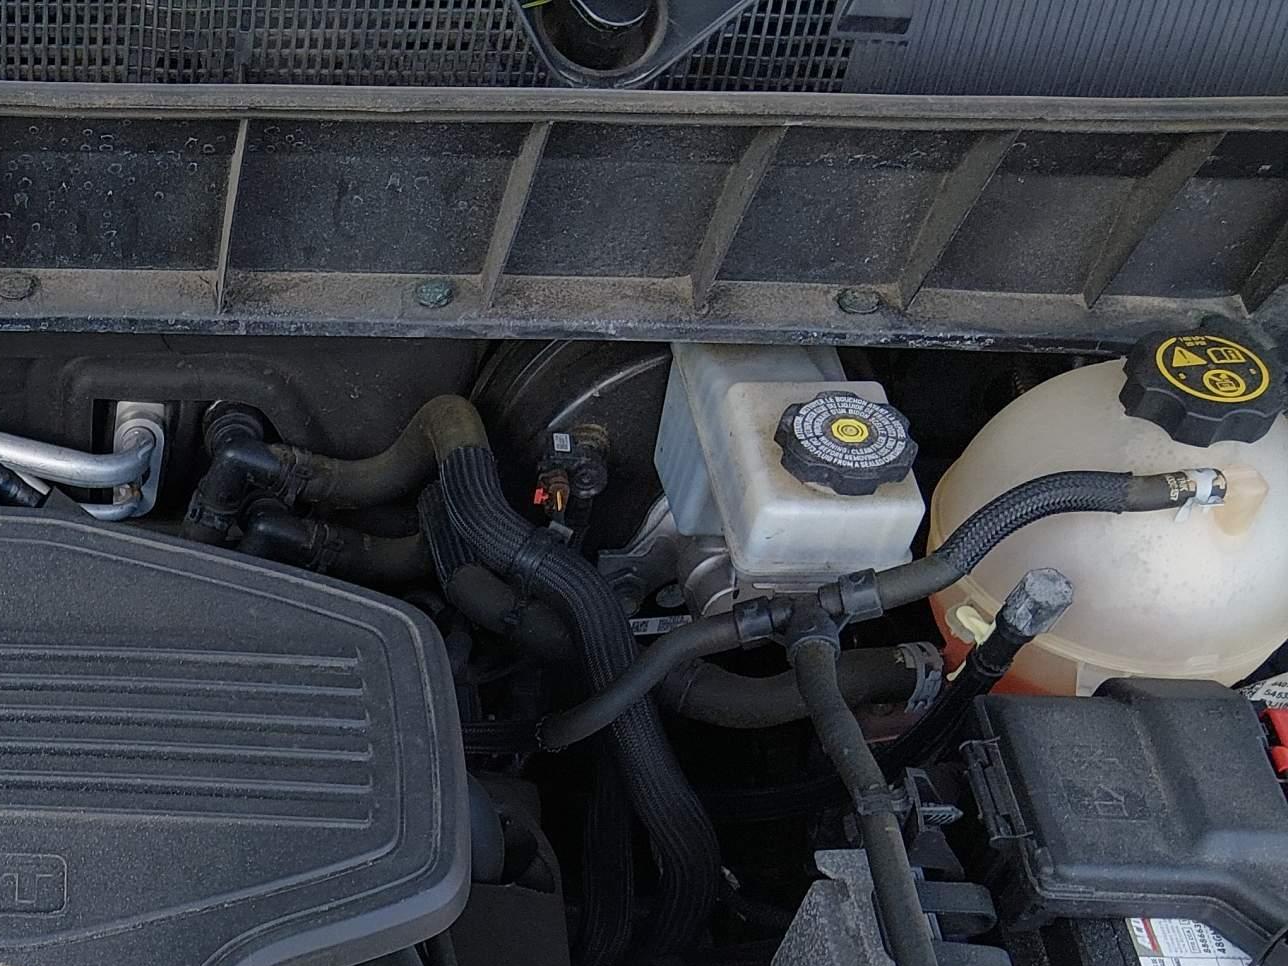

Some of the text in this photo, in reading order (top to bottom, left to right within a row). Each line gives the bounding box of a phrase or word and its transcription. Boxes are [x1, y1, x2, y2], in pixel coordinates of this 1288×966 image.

[834, 396, 867, 406] BOUCHON
[837, 403, 866, 411] LIQUIDE
[848, 409, 870, 419] BIDON
[818, 445, 844, 459] BEFORE
[833, 459, 853, 468] FROM
